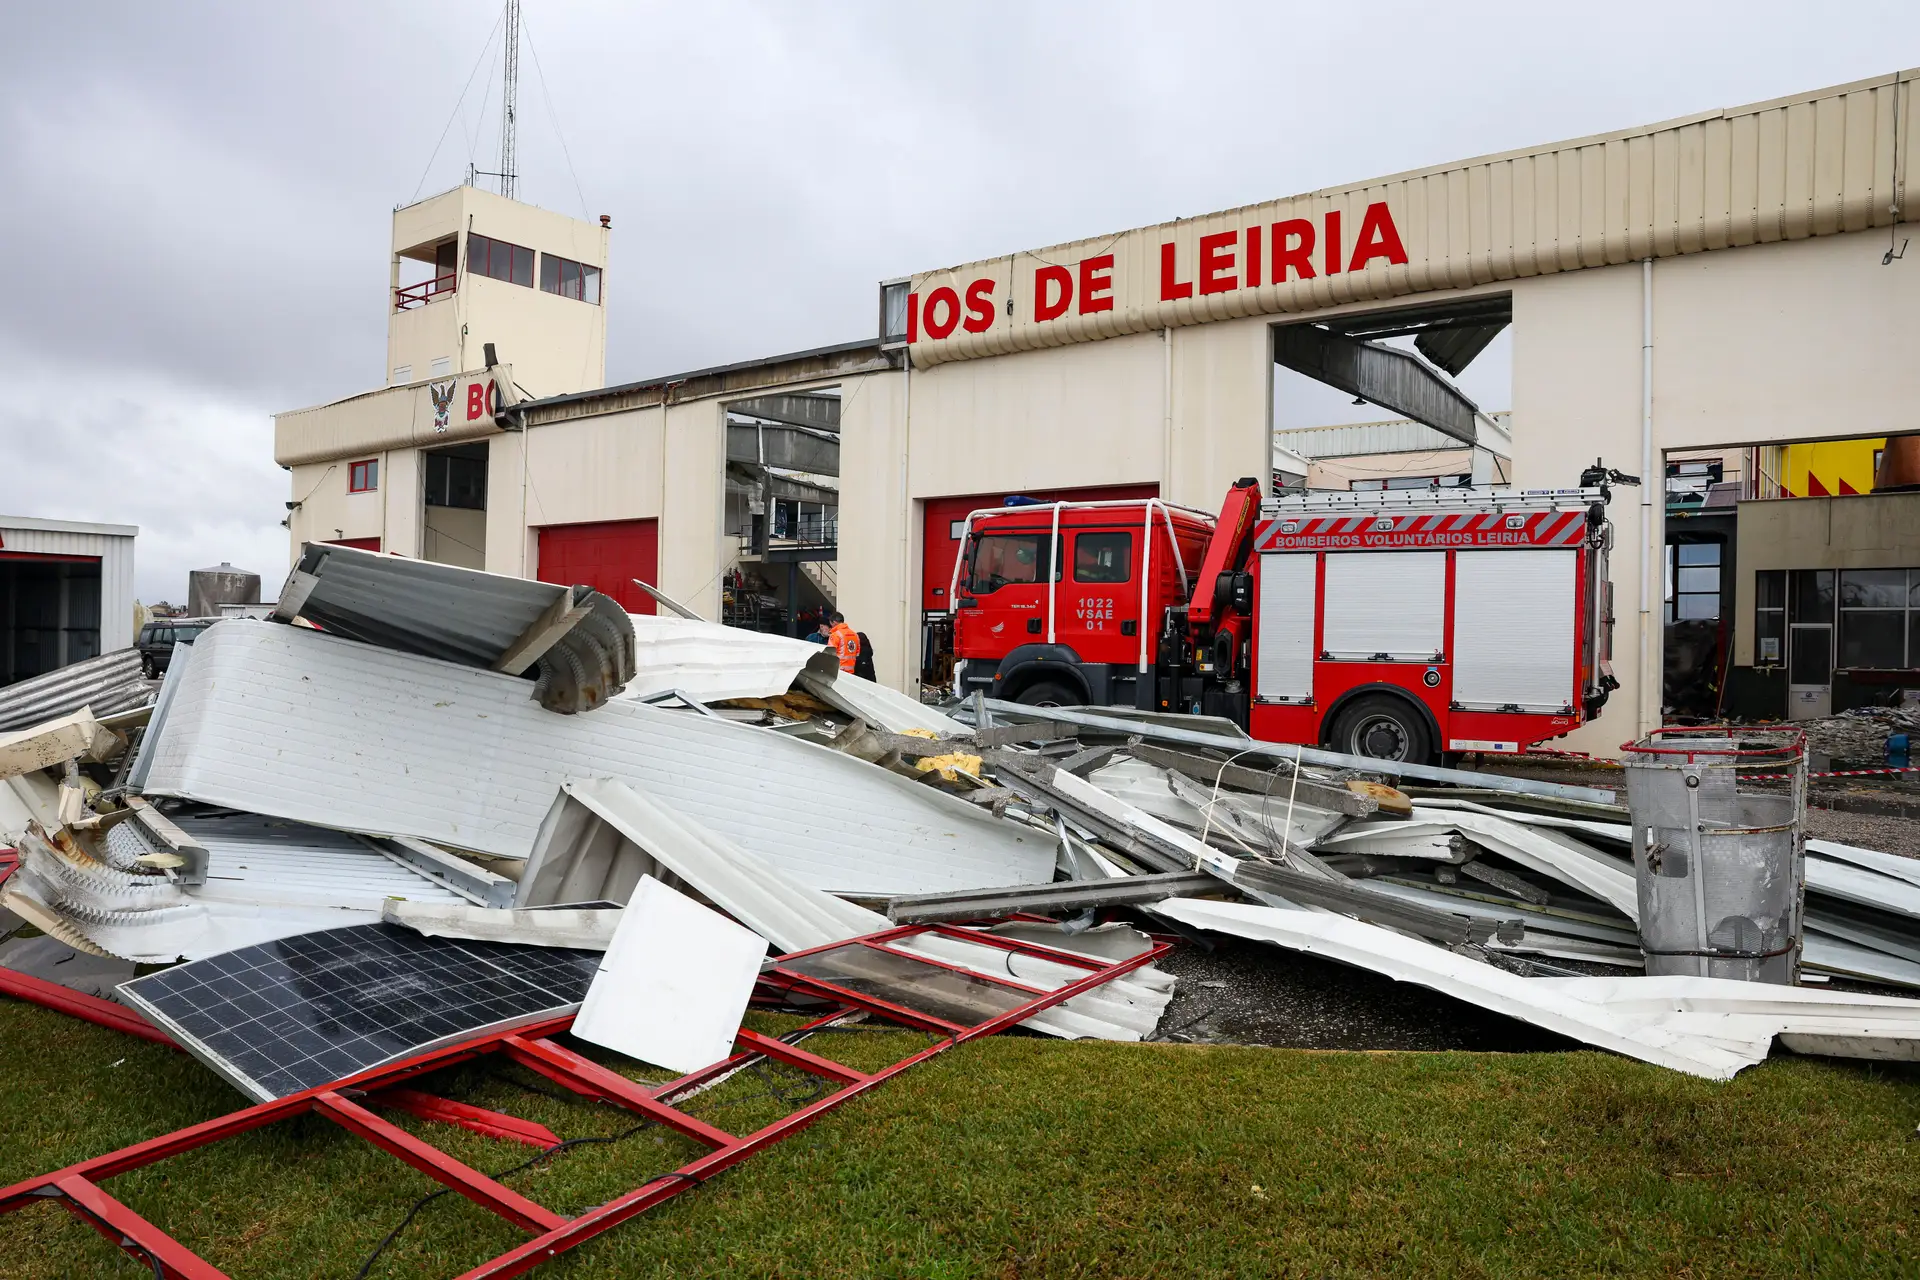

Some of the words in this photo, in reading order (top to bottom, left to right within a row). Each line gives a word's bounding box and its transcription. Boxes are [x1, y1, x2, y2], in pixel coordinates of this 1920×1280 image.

[906, 278, 996, 344] IOS
[1034, 253, 1115, 323] DE
[1161, 201, 1409, 302] LEIRIA
[1276, 534, 1360, 547] BOMBEIROS
[1364, 531, 1473, 545] VOLUNTÁRIOS
[1477, 531, 1530, 544] LEIRIA
[1078, 598, 1113, 608] 1022
[1076, 609, 1113, 619] VSAE
[1086, 620, 1103, 631] 01
